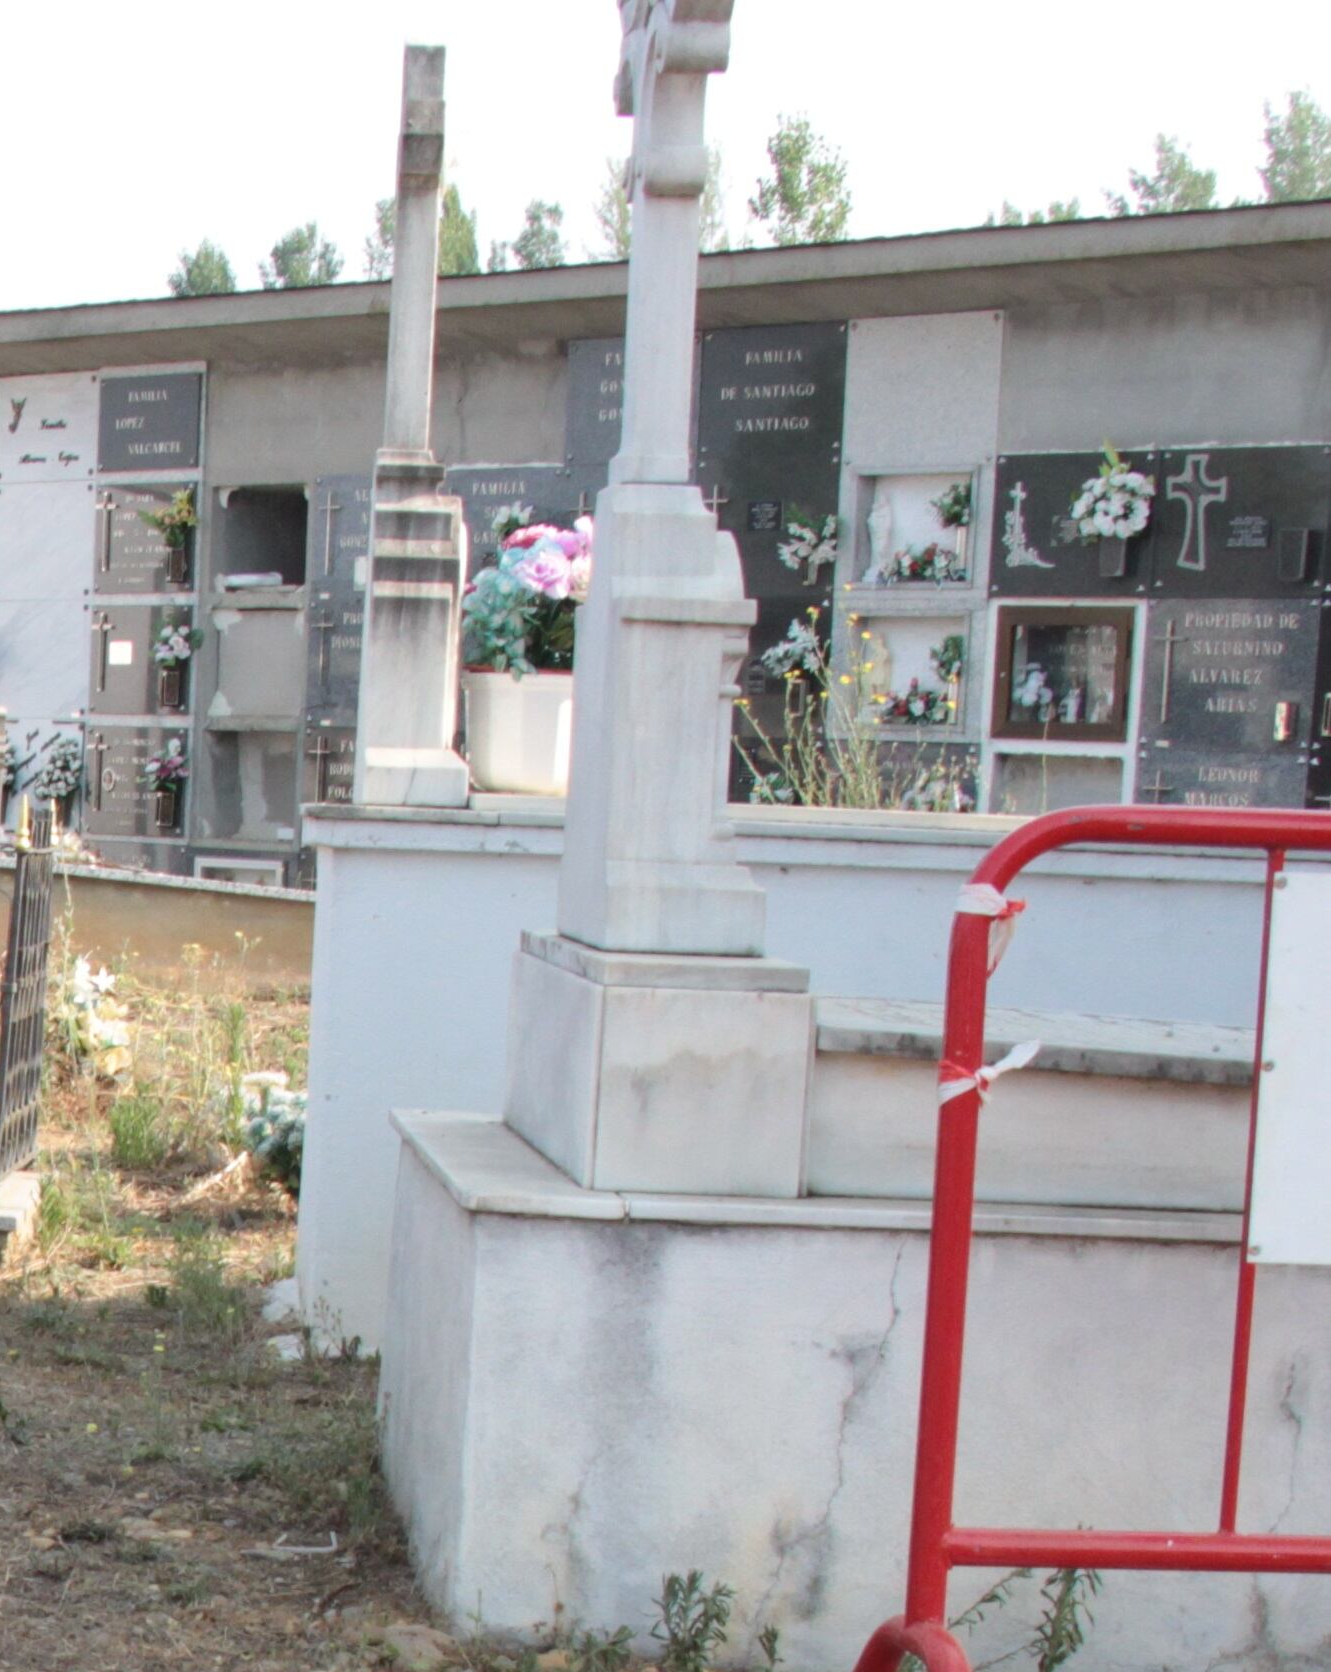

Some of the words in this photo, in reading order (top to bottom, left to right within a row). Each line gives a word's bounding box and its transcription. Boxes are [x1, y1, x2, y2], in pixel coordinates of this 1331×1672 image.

[745, 350, 803, 366] FAMILIA
[128, 389, 169, 403] FAMILIA
[721, 386, 736, 401] DE
[744, 383, 816, 399] SANTIAGO
[114, 416, 146, 431] LOPEZ
[736, 417, 810, 432] SANTIAGO
[1184, 612, 1273, 629] PROPIEDAD
[1279, 613, 1301, 629] DE
[1192, 640, 1284, 656] SATURNINO
[1189, 668, 1263, 685] ALVAREZ
[1204, 697, 1258, 713] ARIAS
[1198, 767, 1260, 784] LEONOR
[1184, 792, 1251, 807] MARCOS
